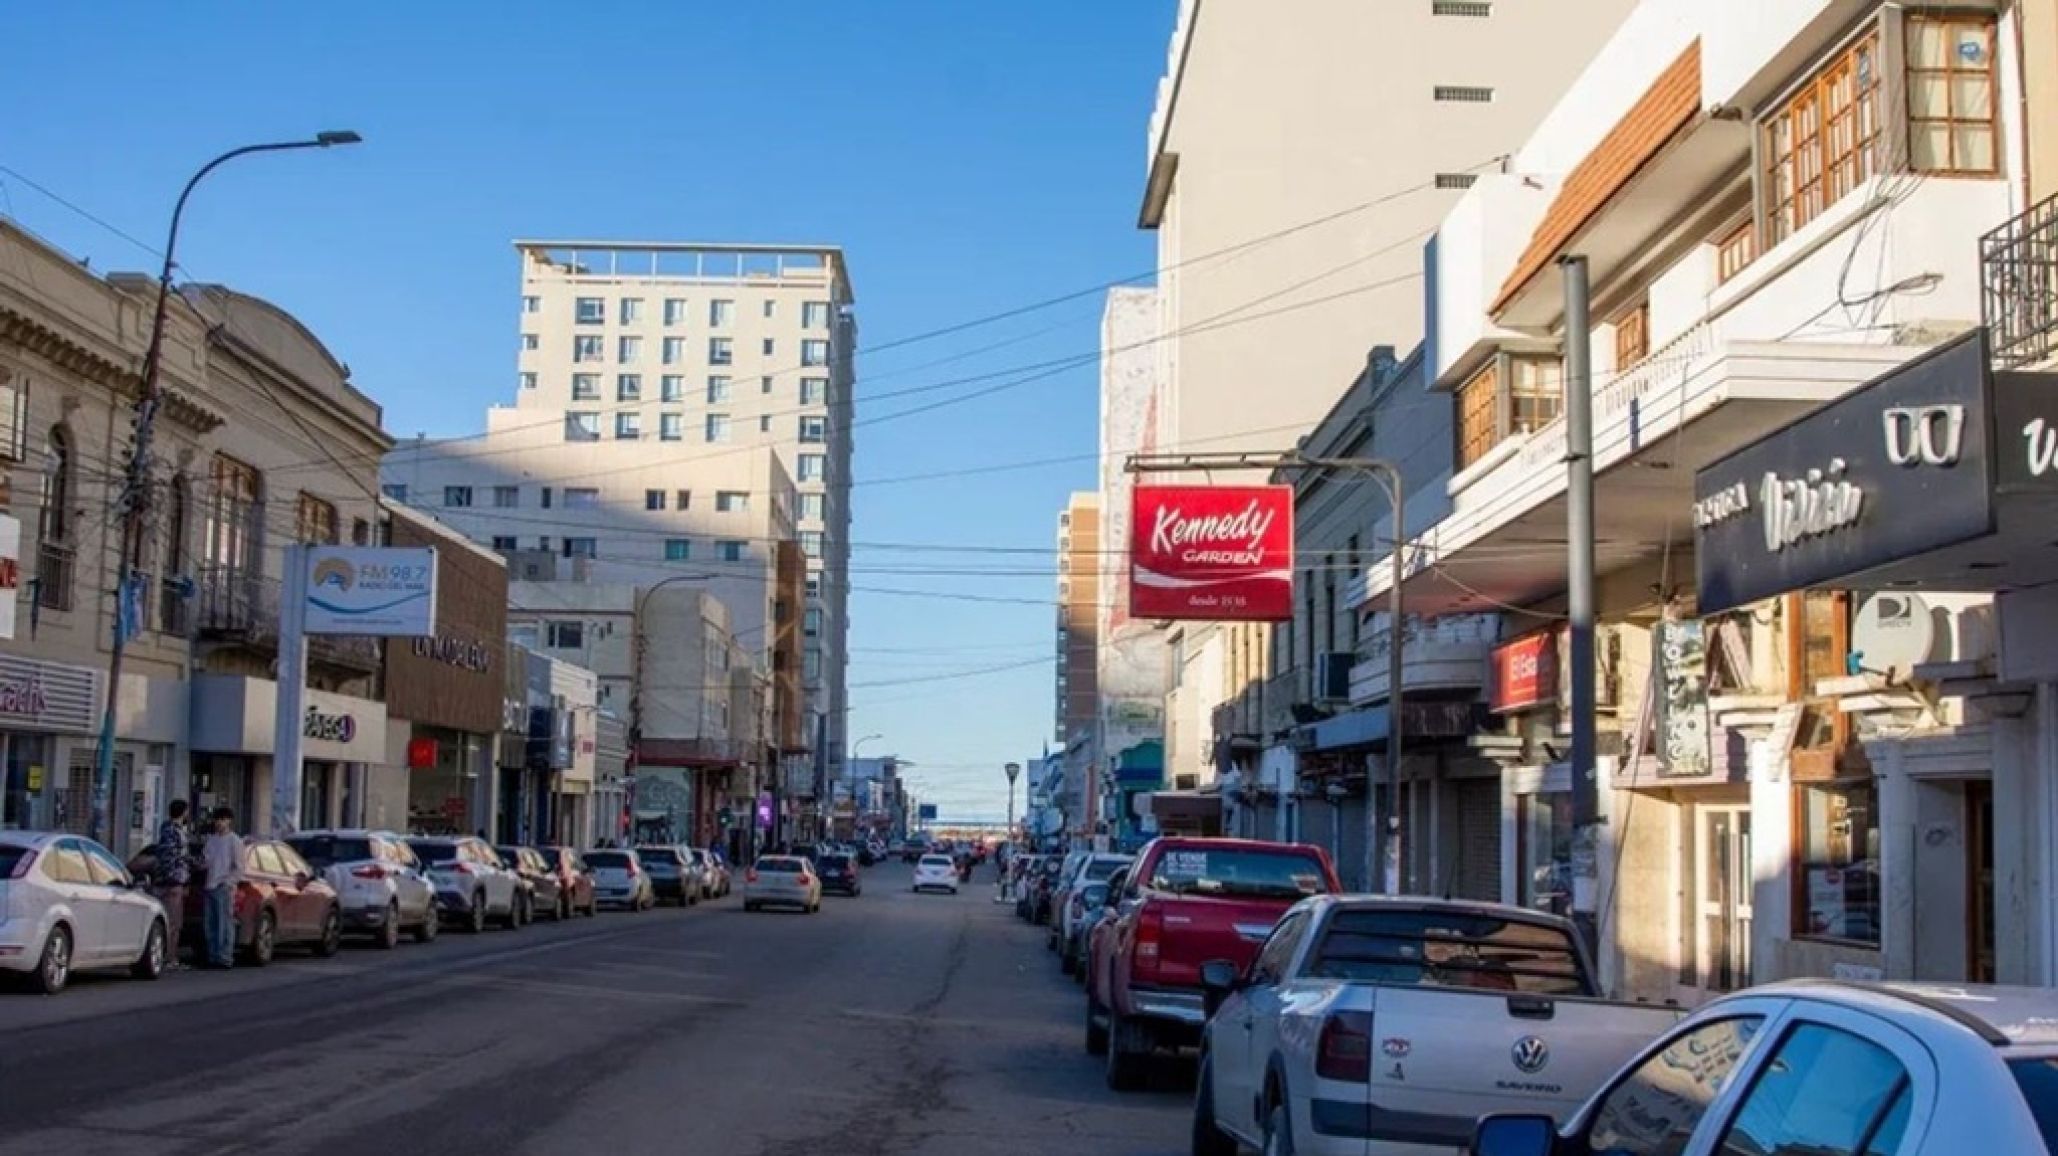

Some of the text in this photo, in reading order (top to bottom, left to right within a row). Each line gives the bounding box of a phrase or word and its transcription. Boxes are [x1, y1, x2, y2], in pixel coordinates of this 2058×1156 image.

[1152, 498, 1275, 554] Kennedy
[1182, 549, 1265, 565] GARDEN
[360, 565, 388, 580] FM
[1495, 1080, 1562, 1094] SAVEIRO
